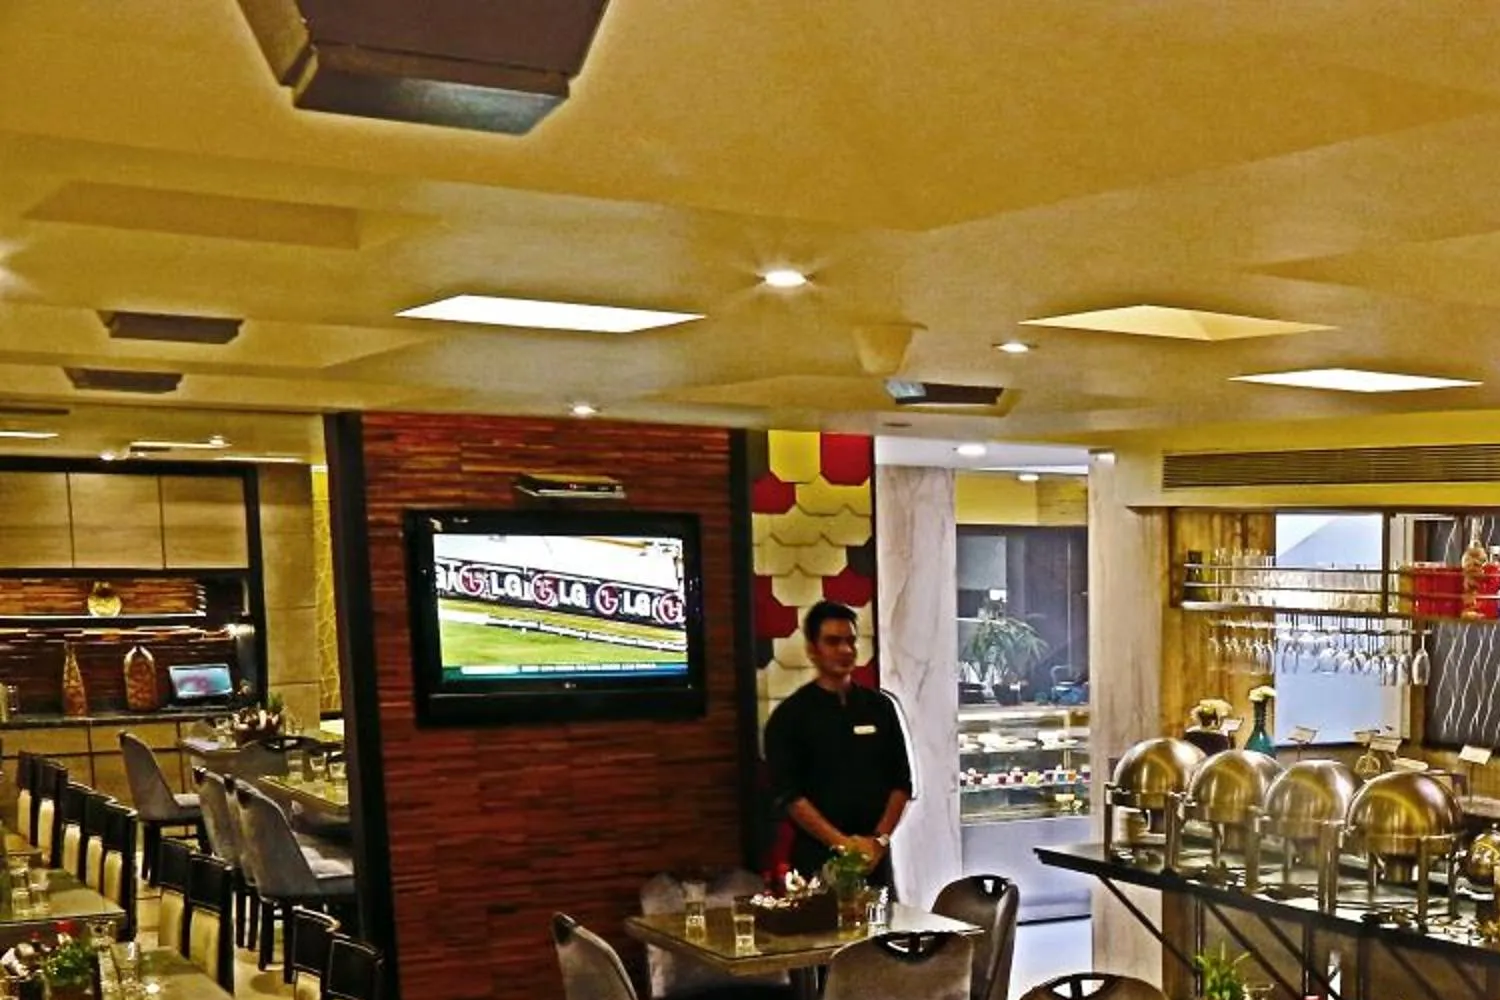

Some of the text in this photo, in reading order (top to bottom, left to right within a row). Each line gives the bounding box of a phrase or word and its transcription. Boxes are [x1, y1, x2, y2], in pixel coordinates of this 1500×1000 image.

[490, 571, 522, 597] LG
[559, 580, 589, 608] LG
[623, 590, 651, 616] LG
